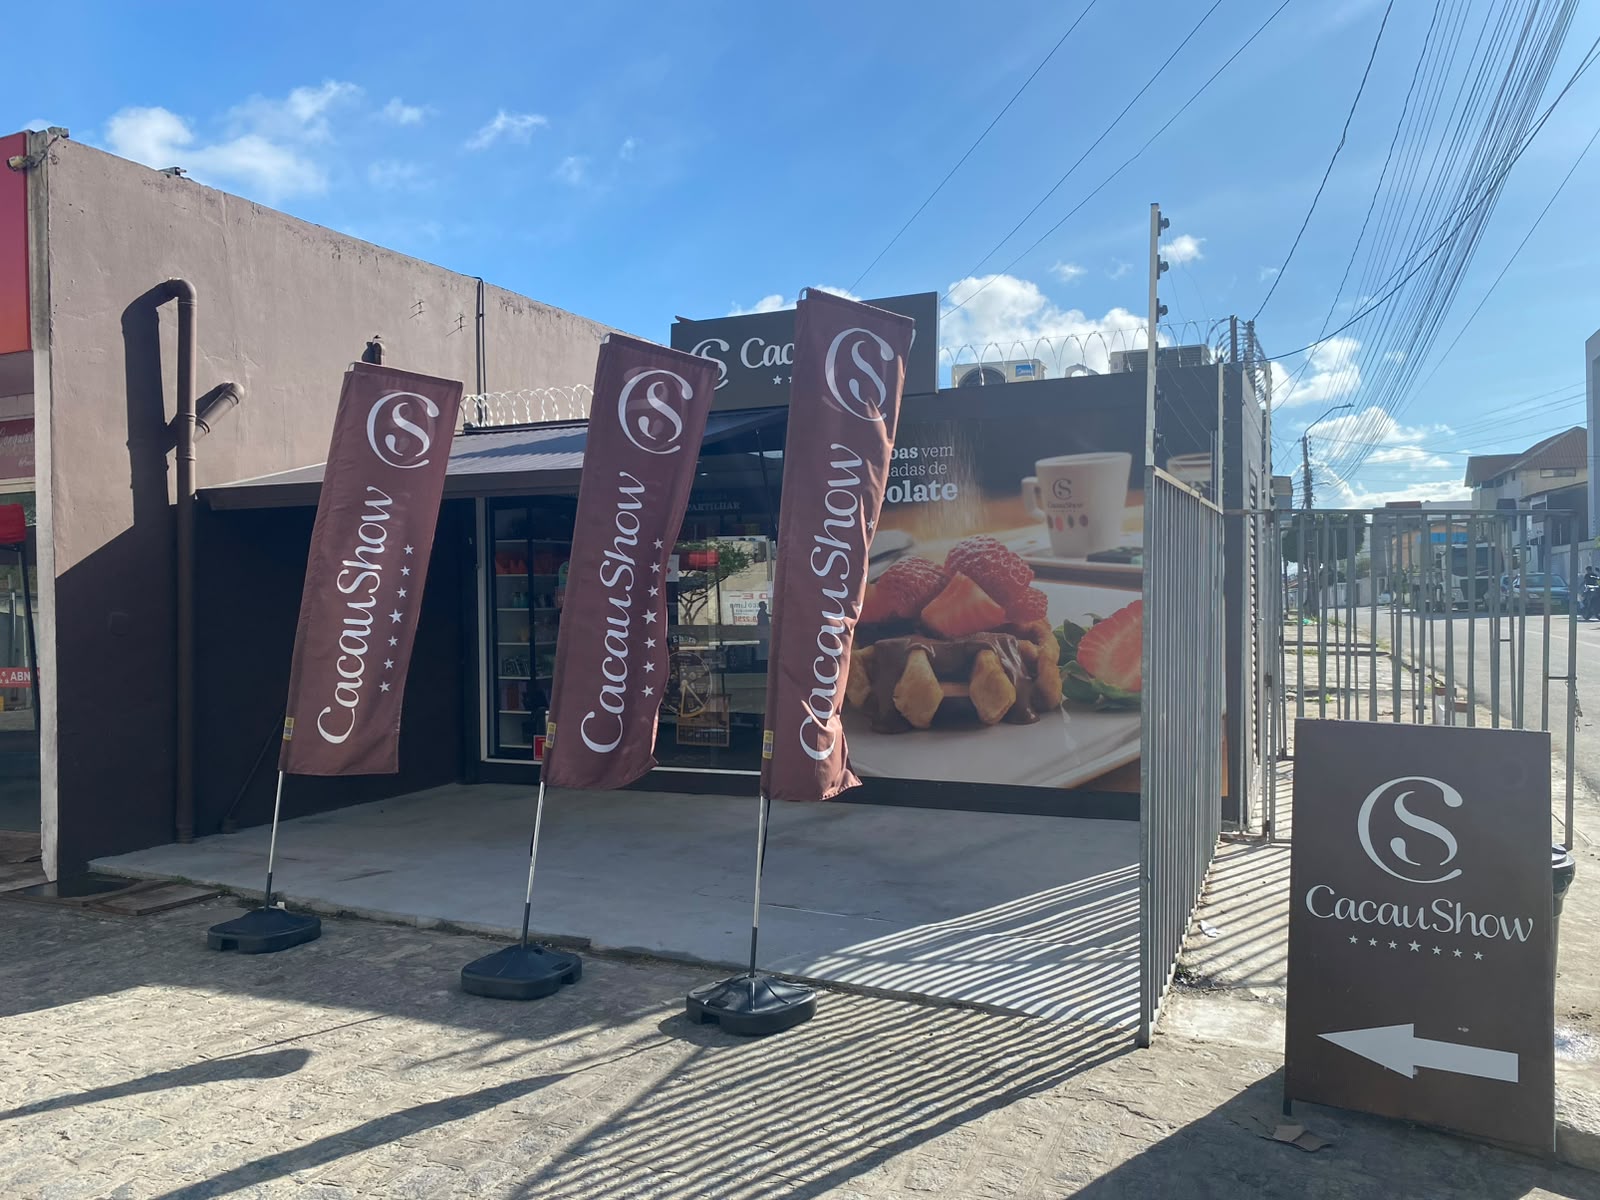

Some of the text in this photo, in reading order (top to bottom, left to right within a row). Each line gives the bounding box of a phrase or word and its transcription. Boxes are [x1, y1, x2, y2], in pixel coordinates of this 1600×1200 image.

[887, 461, 947, 477] adas de
[921, 445, 954, 458] vem
[883, 479, 958, 503] olate
[317, 485, 393, 744] CacauShow
[580, 470, 646, 754] CacauShow
[799, 442, 863, 761] CacauShow
[1305, 884, 1534, 942] CacauShow
